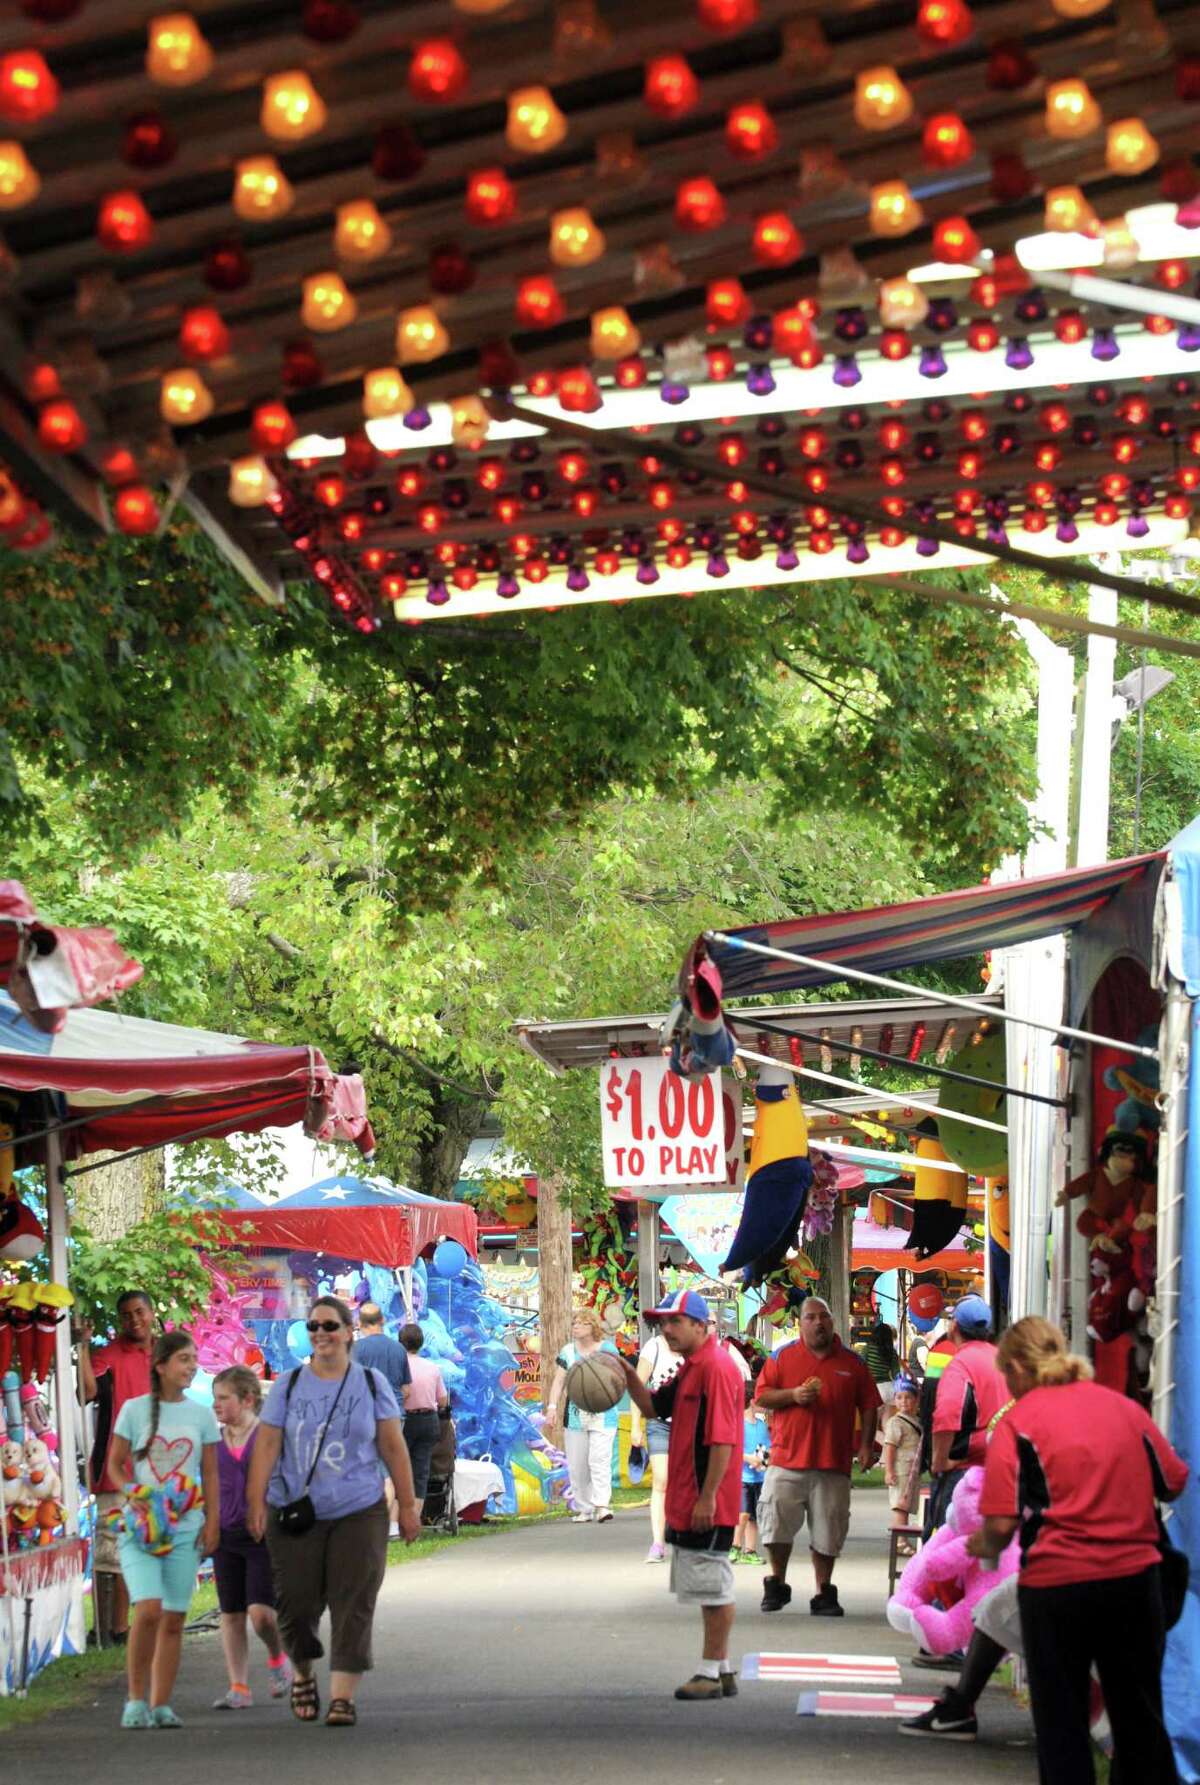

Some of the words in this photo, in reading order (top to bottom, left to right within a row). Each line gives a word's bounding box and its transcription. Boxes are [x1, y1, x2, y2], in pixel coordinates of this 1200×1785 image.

[607, 1066, 715, 1140] $1.00
[612, 1147, 645, 1176] TO
[659, 1144, 718, 1175] PLAY
